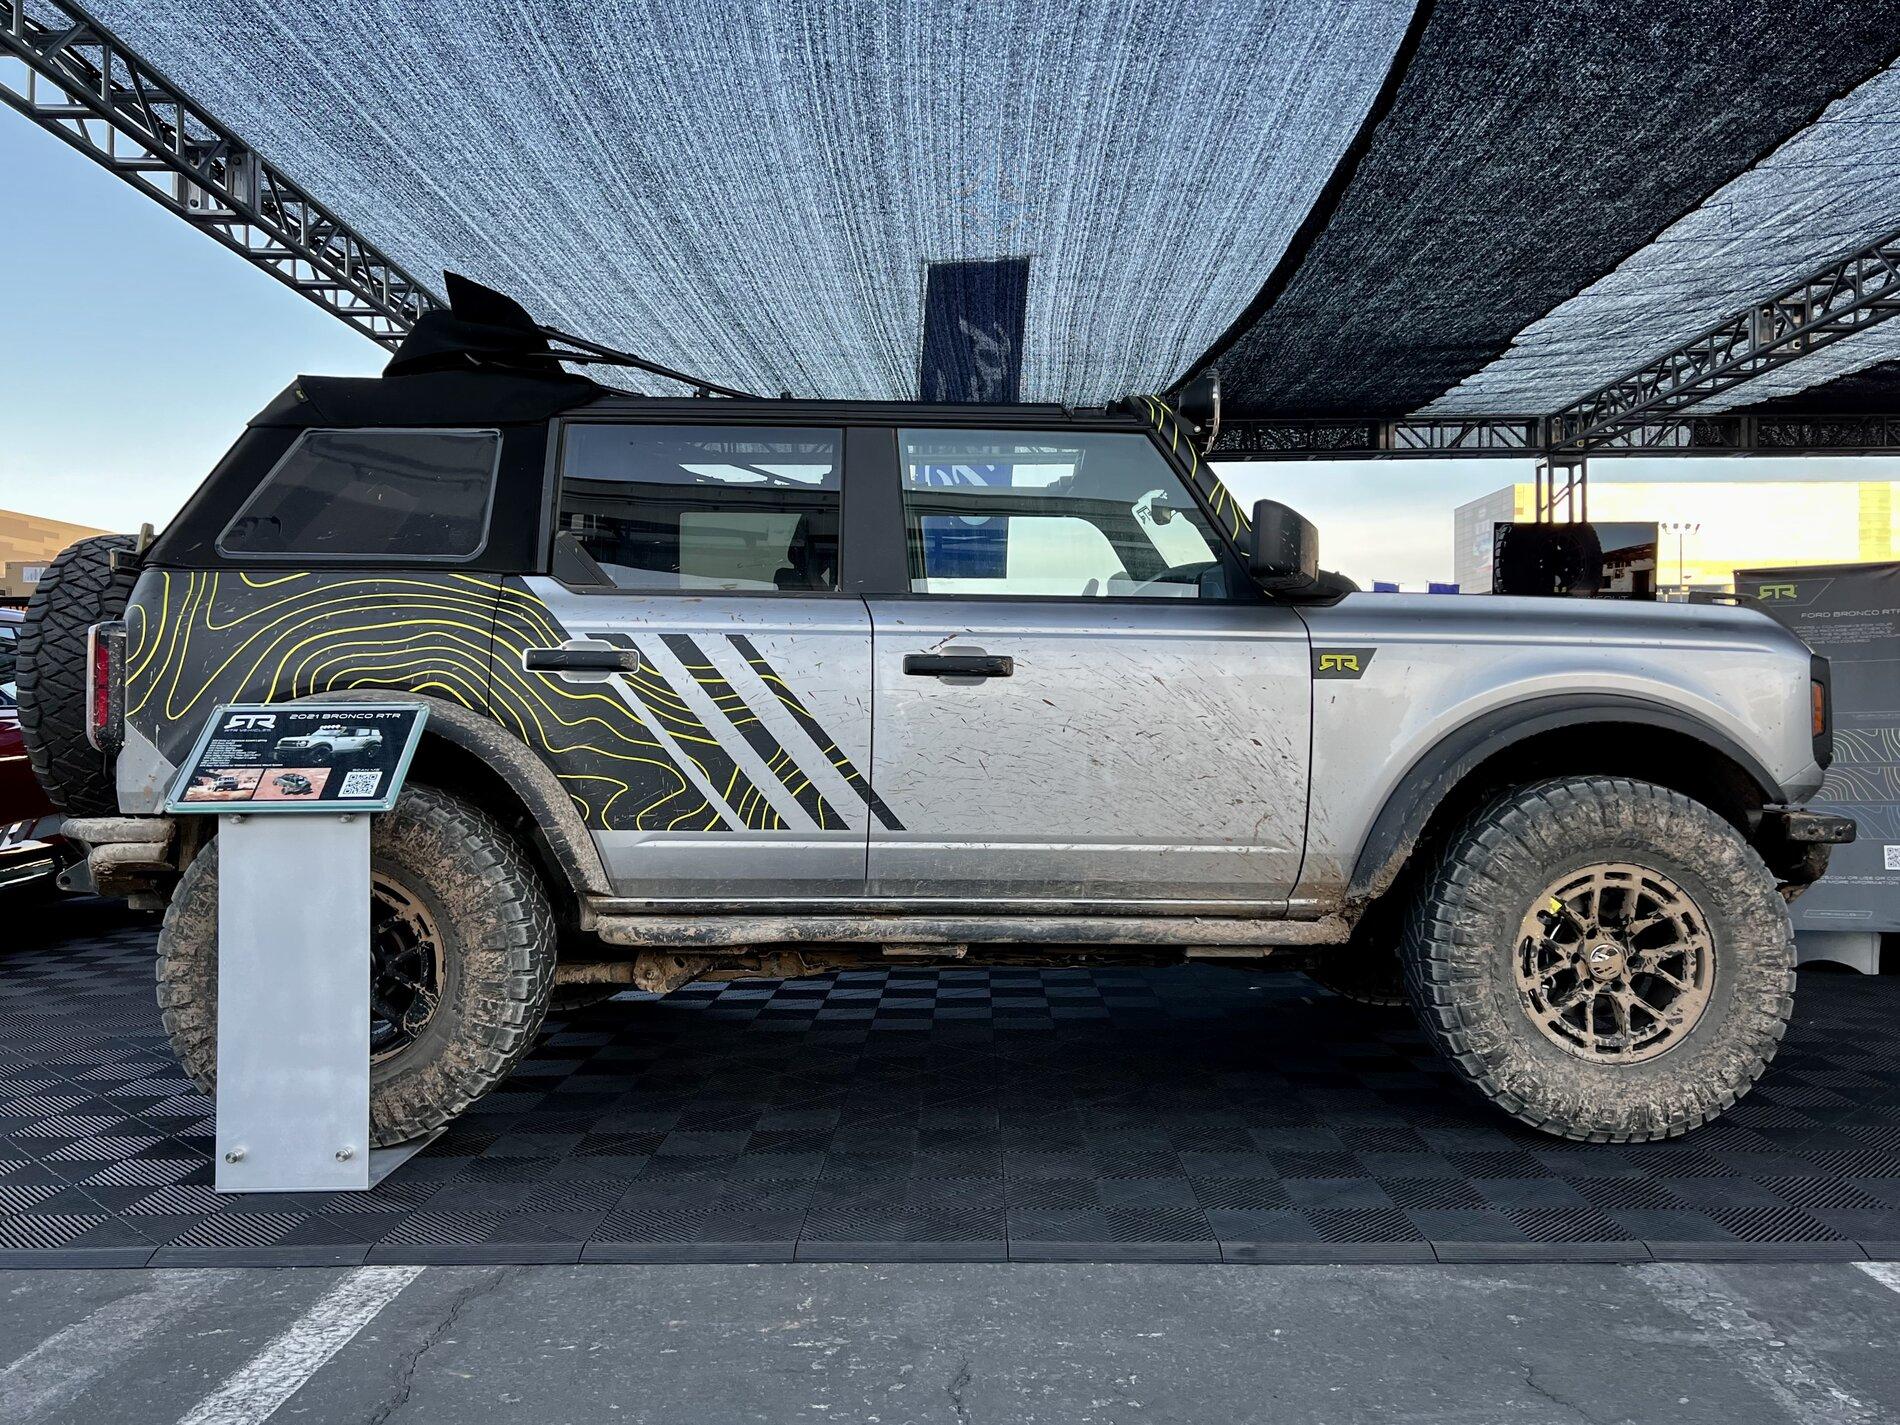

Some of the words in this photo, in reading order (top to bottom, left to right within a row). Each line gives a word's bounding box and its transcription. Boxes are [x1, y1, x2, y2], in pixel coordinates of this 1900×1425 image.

[1758, 584, 1797, 600] RTR
[1801, 611, 1831, 619] FORD
[1833, 609, 1880, 618] BRONCO
[1319, 654, 1359, 671] RTR
[223, 714, 277, 729] RTR
